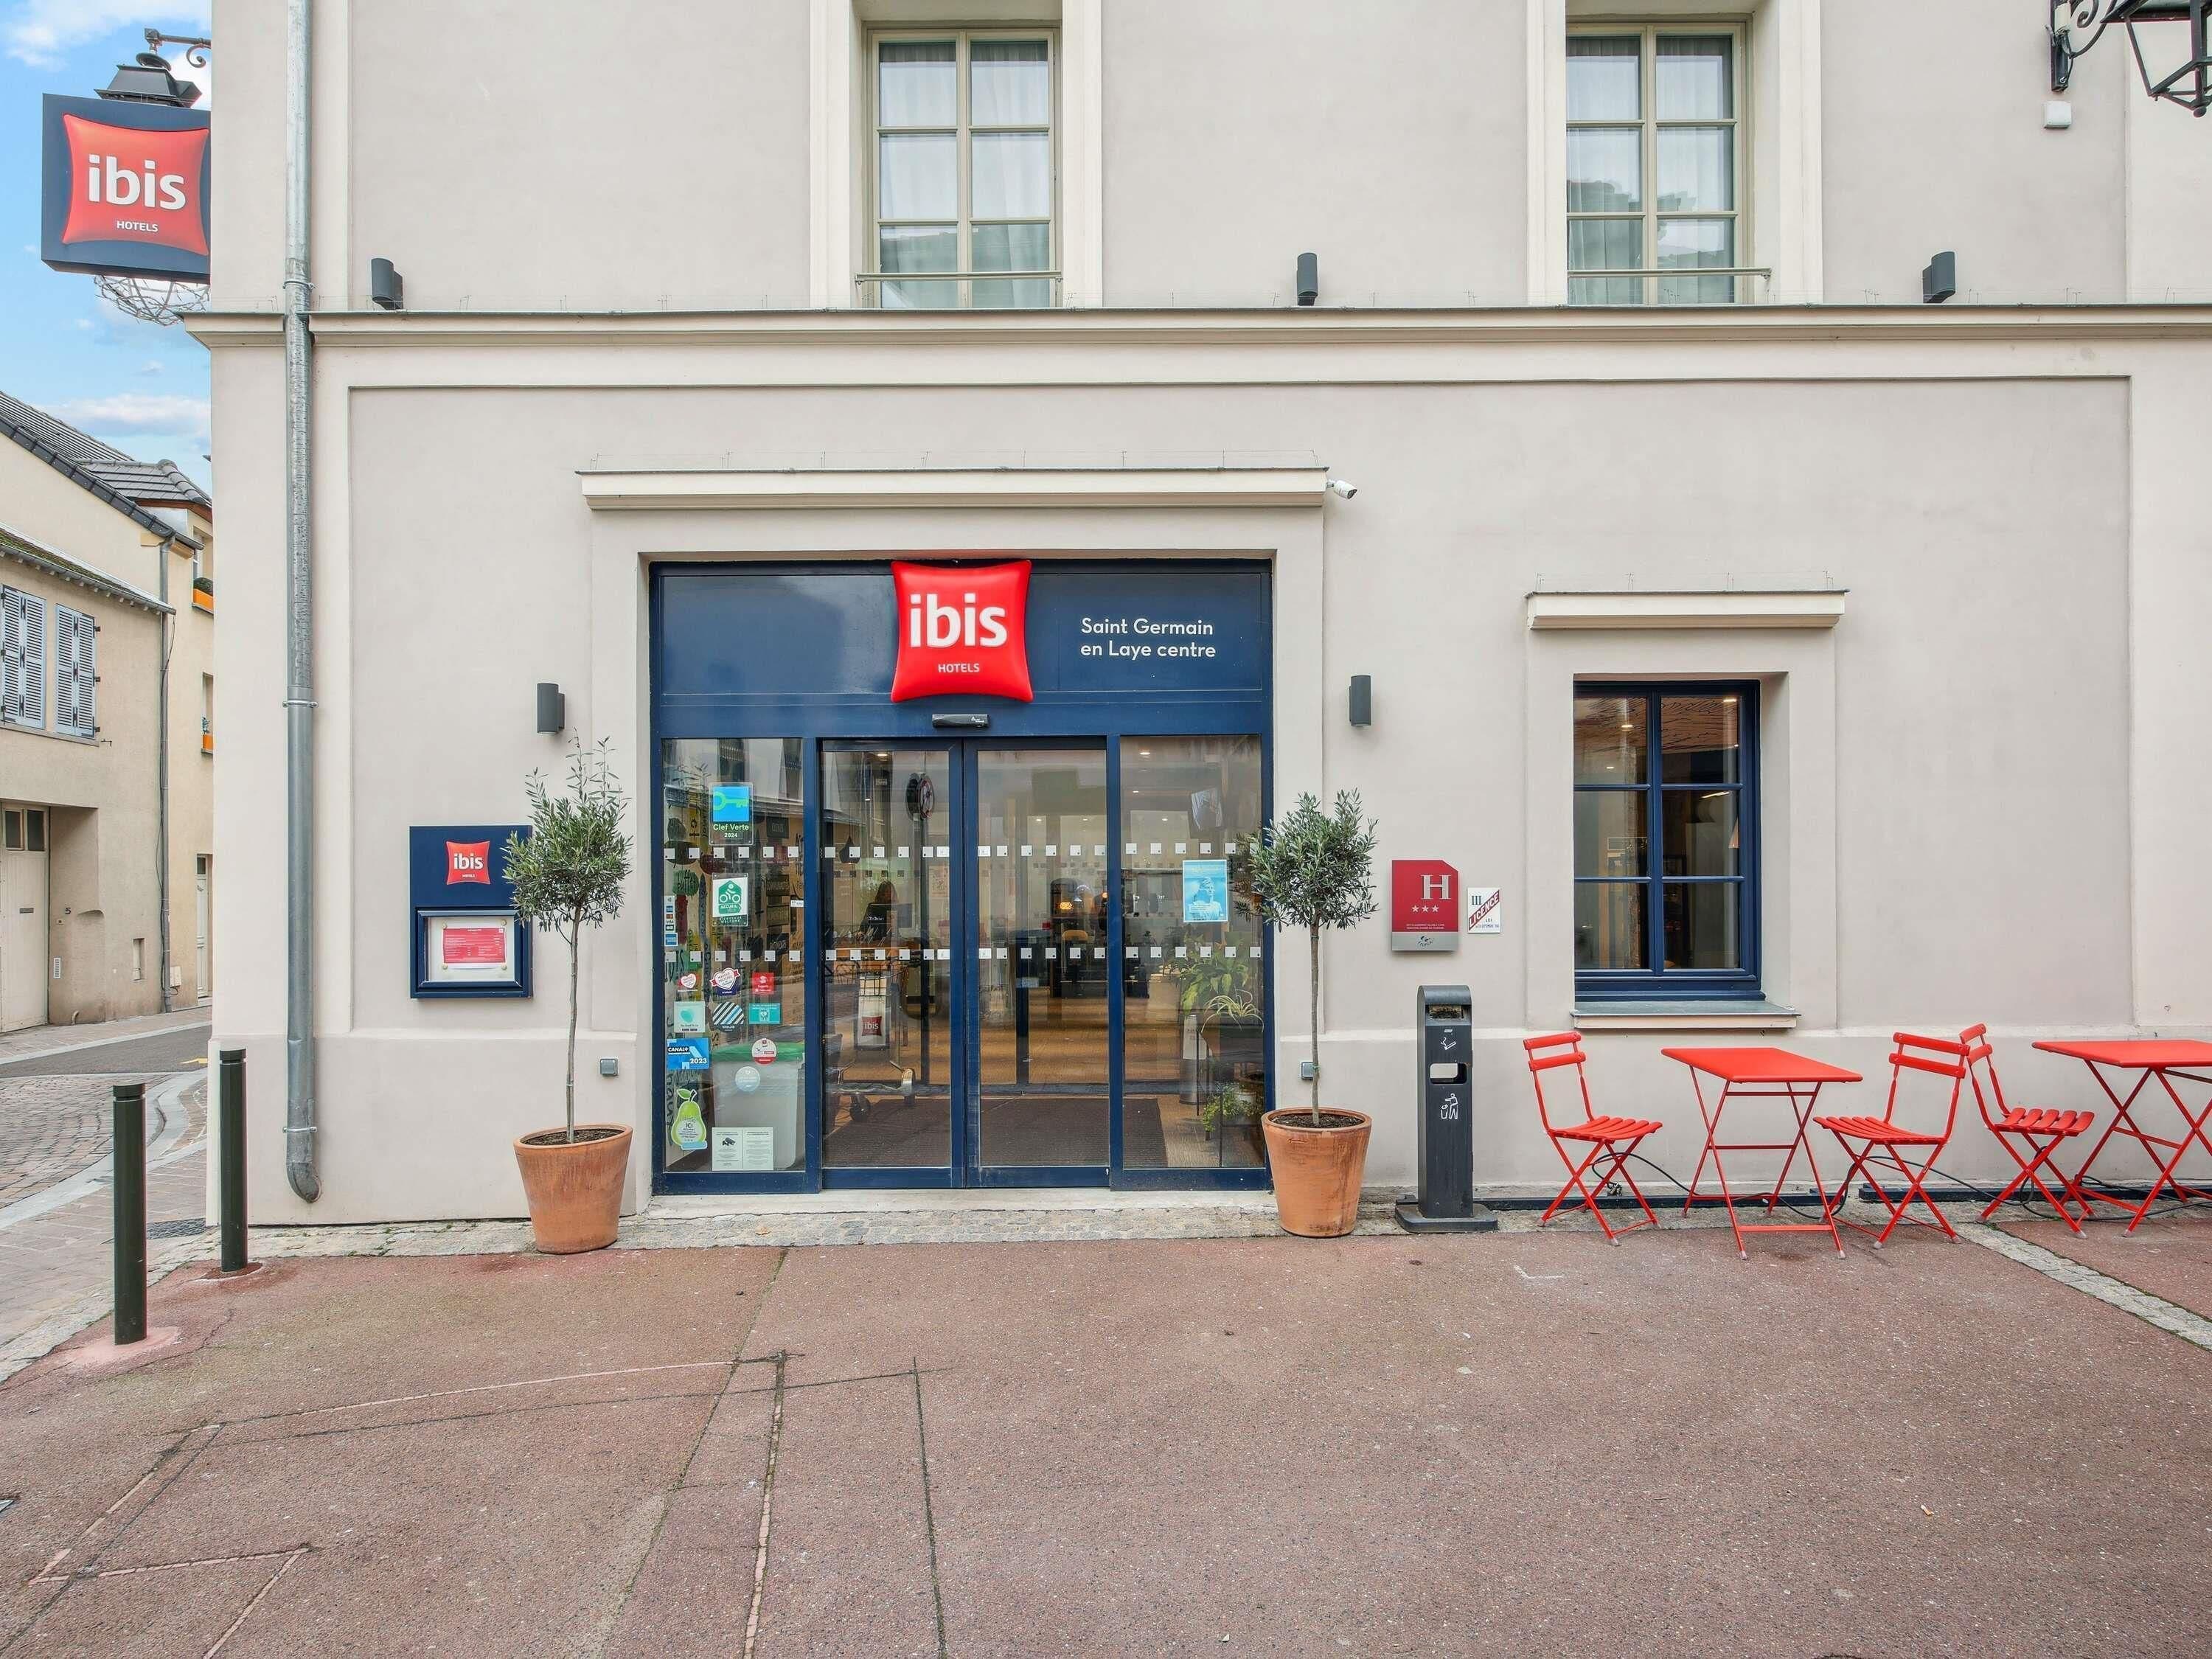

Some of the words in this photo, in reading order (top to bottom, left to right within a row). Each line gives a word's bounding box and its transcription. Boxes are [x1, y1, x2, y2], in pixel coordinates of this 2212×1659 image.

[88, 154, 187, 210] ibis
[116, 220, 159, 232] HOTELS
[909, 593, 1008, 649] ibis
[1081, 617, 1128, 635] Saint
[1133, 618, 1214, 636] Germain
[1080, 643, 1103, 657] en
[1108, 641, 1152, 661] Laye
[1157, 642, 1217, 658] centre
[937, 662, 981, 674] HOTELS
[713, 823, 728, 832] Clef
[729, 823, 750, 832] Verte
[453, 853, 484, 869] ibis
[1420, 874, 1452, 900] H
[1472, 895, 1481, 905] III
[65, 907, 72, 915] 5
[1469, 891, 1499, 928] LICENCE
[864, 1021, 879, 1030] ibis
